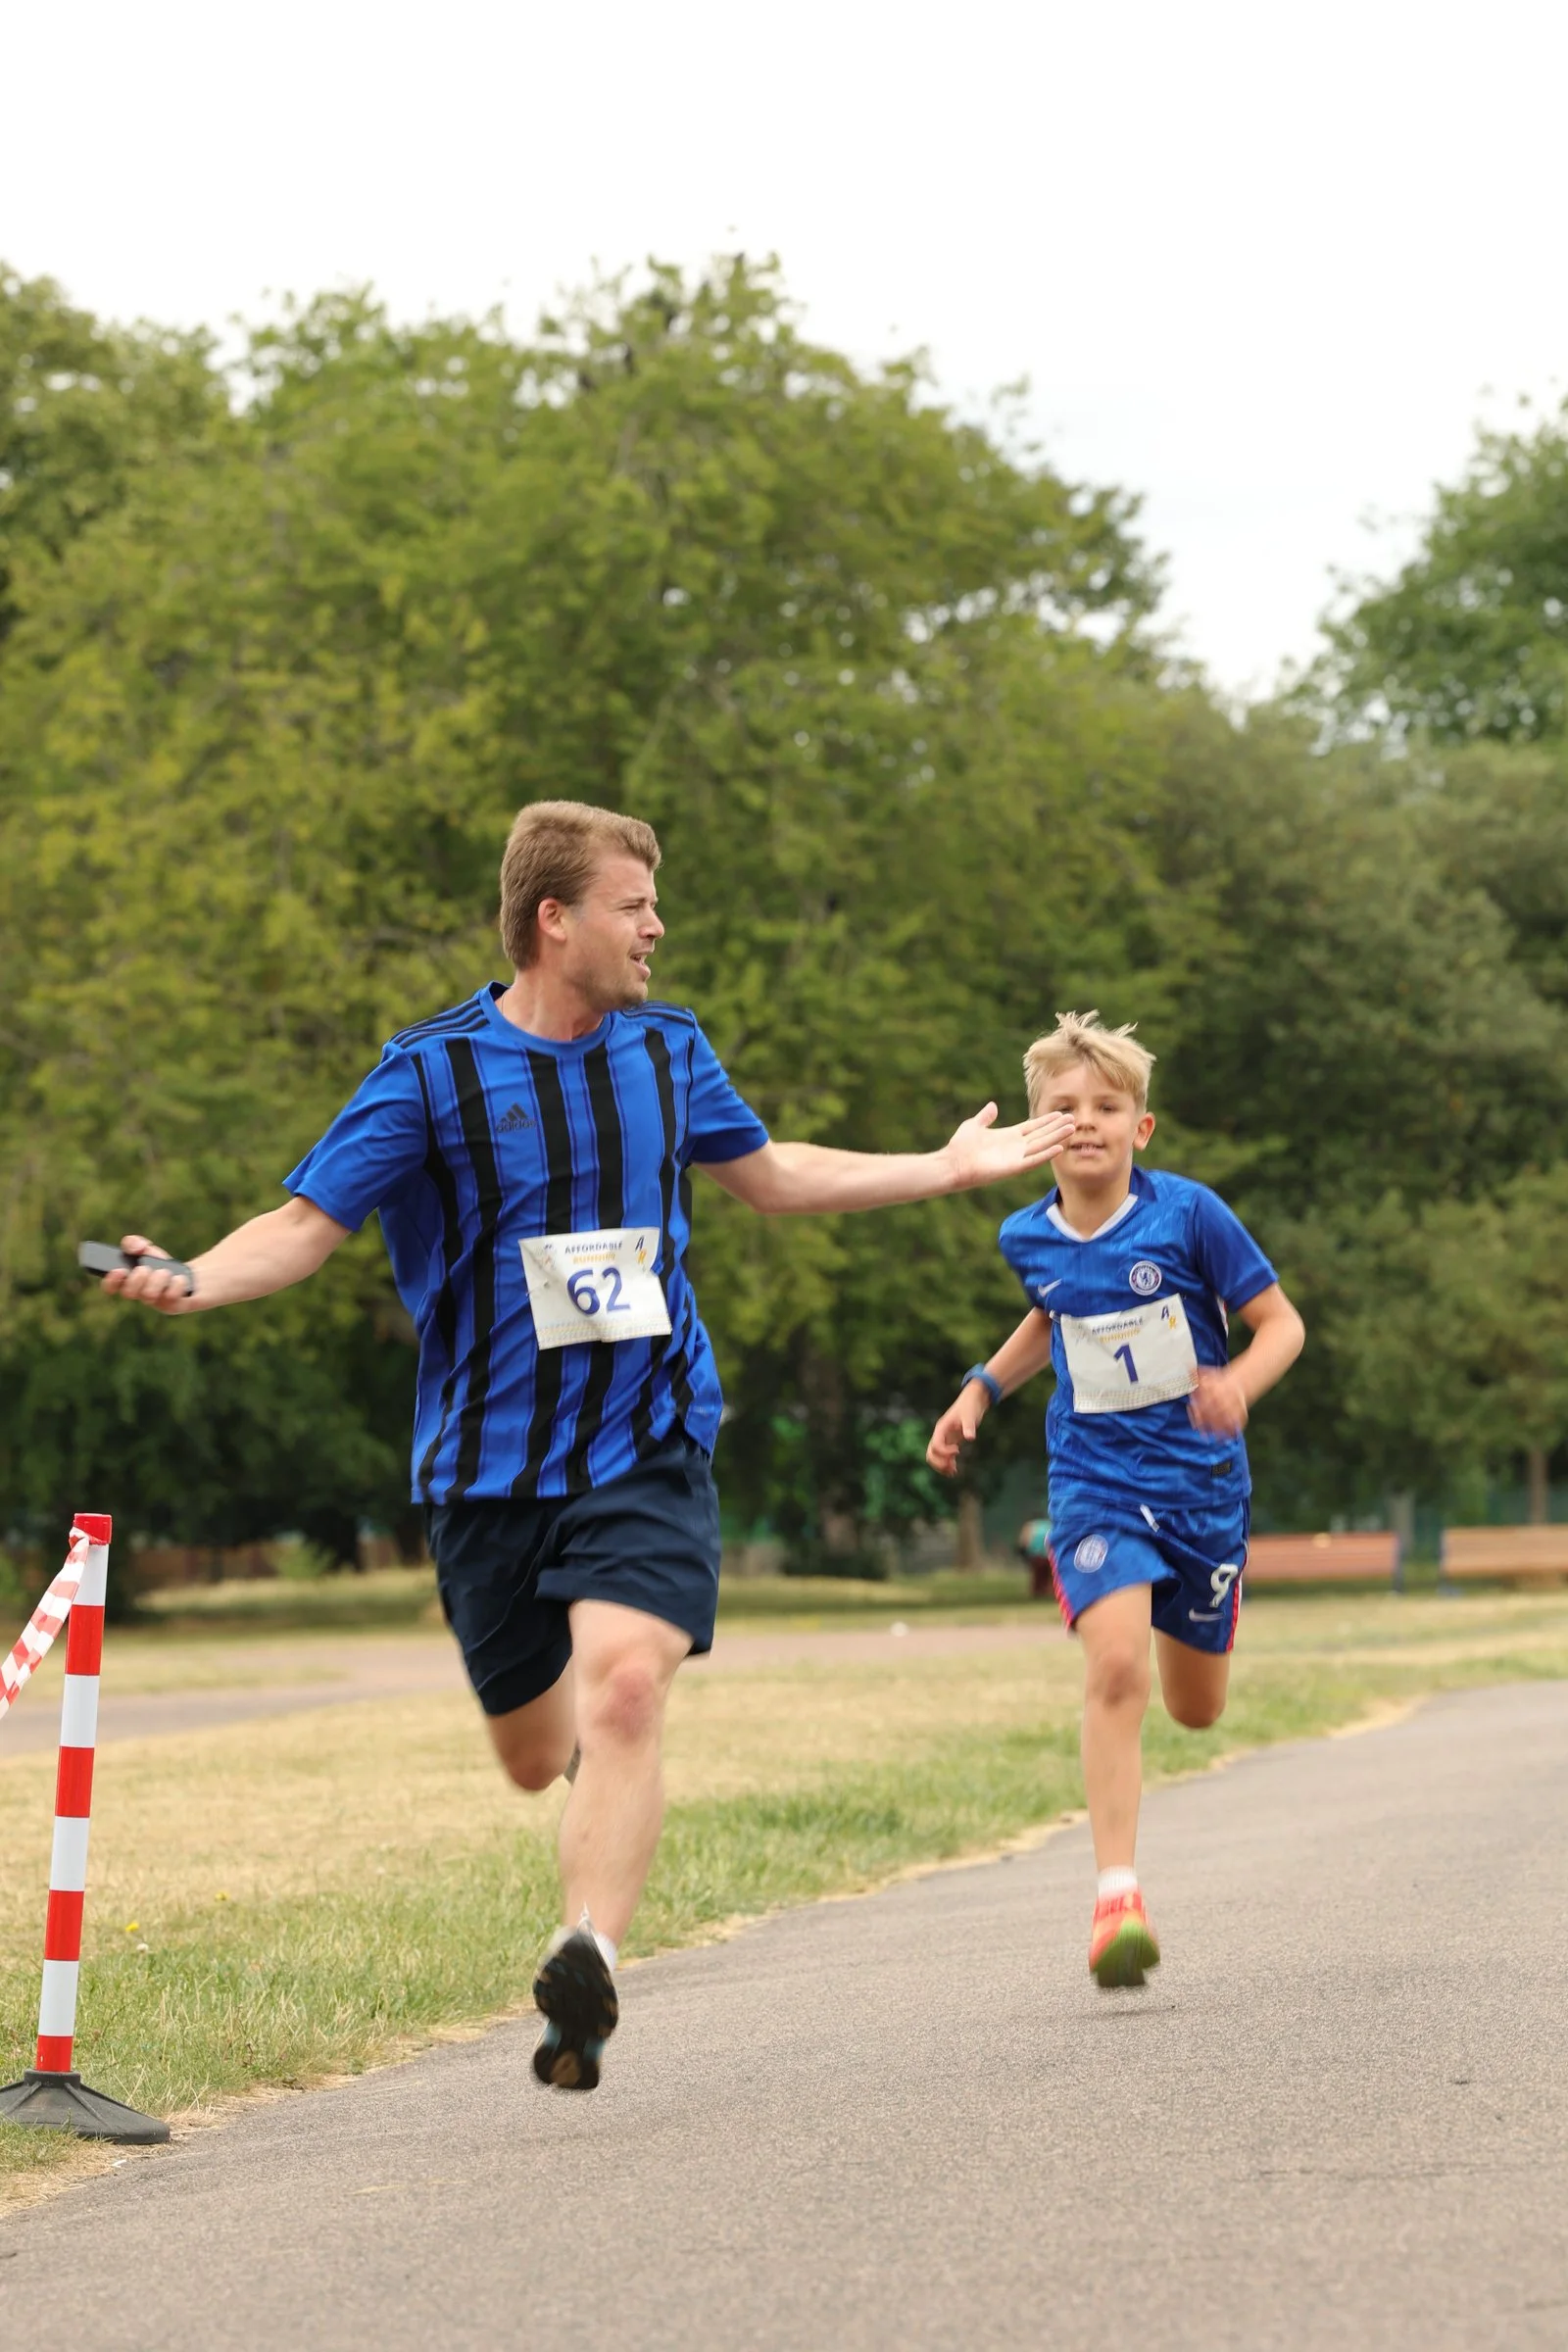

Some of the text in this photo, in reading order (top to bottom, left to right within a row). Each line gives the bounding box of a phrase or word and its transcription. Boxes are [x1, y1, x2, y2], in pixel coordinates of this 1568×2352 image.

[566, 1267, 631, 1317] 62
[1113, 1343, 1139, 1385] 1
[1209, 1563, 1238, 1608] 9
